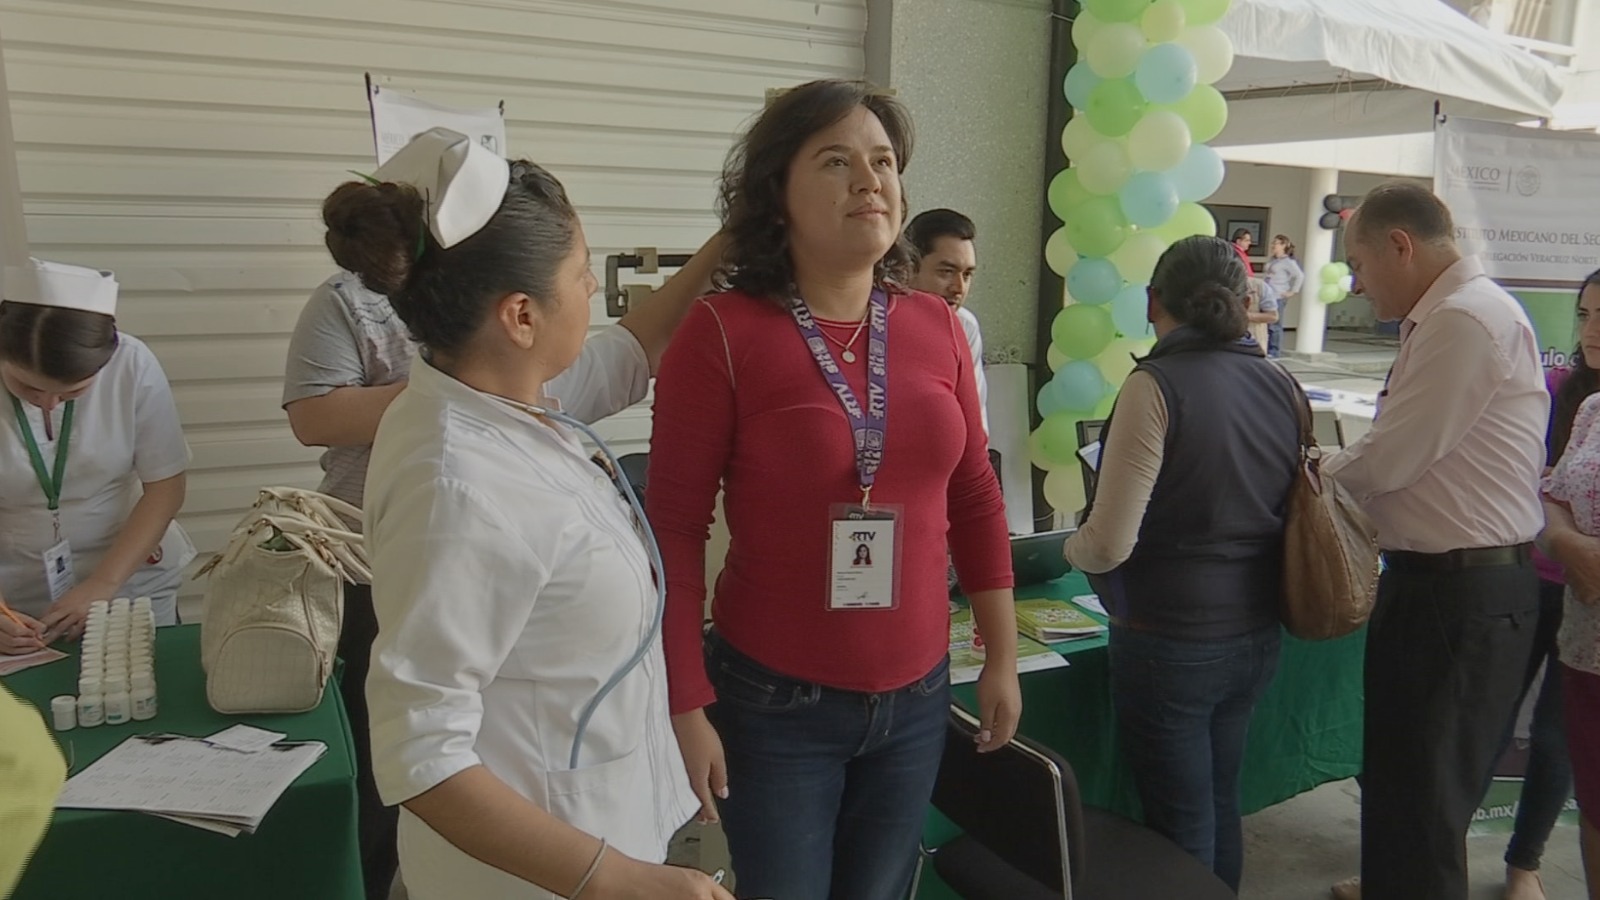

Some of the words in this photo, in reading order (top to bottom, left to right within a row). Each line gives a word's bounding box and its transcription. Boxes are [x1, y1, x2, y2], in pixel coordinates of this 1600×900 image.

[1499, 228, 1558, 244] MEXICANO
[1560, 232, 1581, 246] DEL
[832, 382, 859, 416] RTV
[869, 382, 885, 414] RTV
[852, 531, 876, 541] RTV
